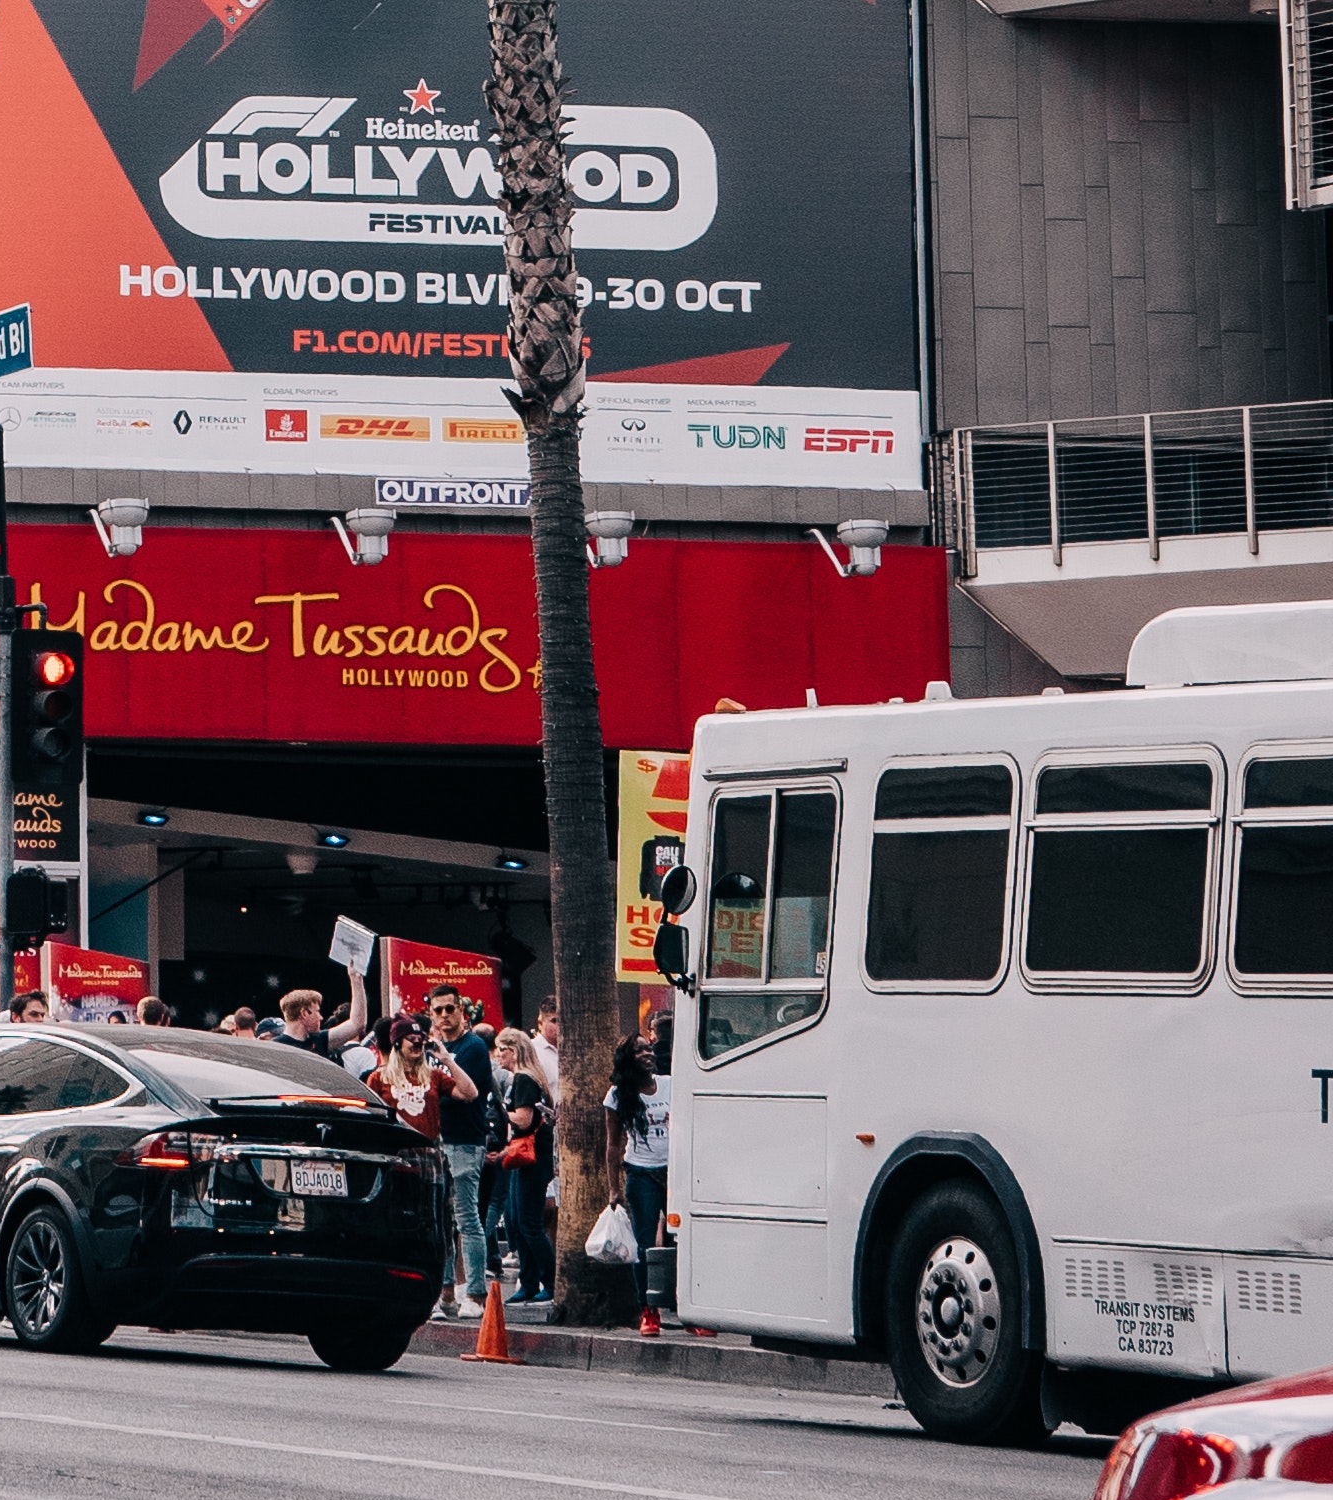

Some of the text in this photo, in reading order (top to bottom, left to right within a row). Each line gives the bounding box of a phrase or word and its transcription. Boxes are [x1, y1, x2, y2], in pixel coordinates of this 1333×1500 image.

[365, 117, 480, 142] Heineken
[205, 141, 671, 203] HOLLYWOD
[119, 264, 406, 303] HOLLYWOOD
[676, 280, 762, 314] OCT
[8, 320, 26, 357] Bl
[199, 415, 247, 424] RENAULT
[336, 418, 416, 437] DHL
[449, 422, 518, 439] PIRELLI
[687, 424, 786, 450] TUDN
[804, 427, 894, 454] ESPN
[381, 480, 528, 506] OUTFRONT
[254, 584, 521, 692] Tussauds
[341, 667, 469, 688] HOLLYWOOD
[58, 963, 100, 979] Madame
[399, 959, 493, 977] Madame Tussauds
[295, 1170, 343, 1190] 8DJA018
[1094, 1299, 1196, 1323] TRANSIT SYSTEMS
[1115, 1318, 1137, 1335] TCP
[1118, 1336, 1174, 1356] CA 83723
